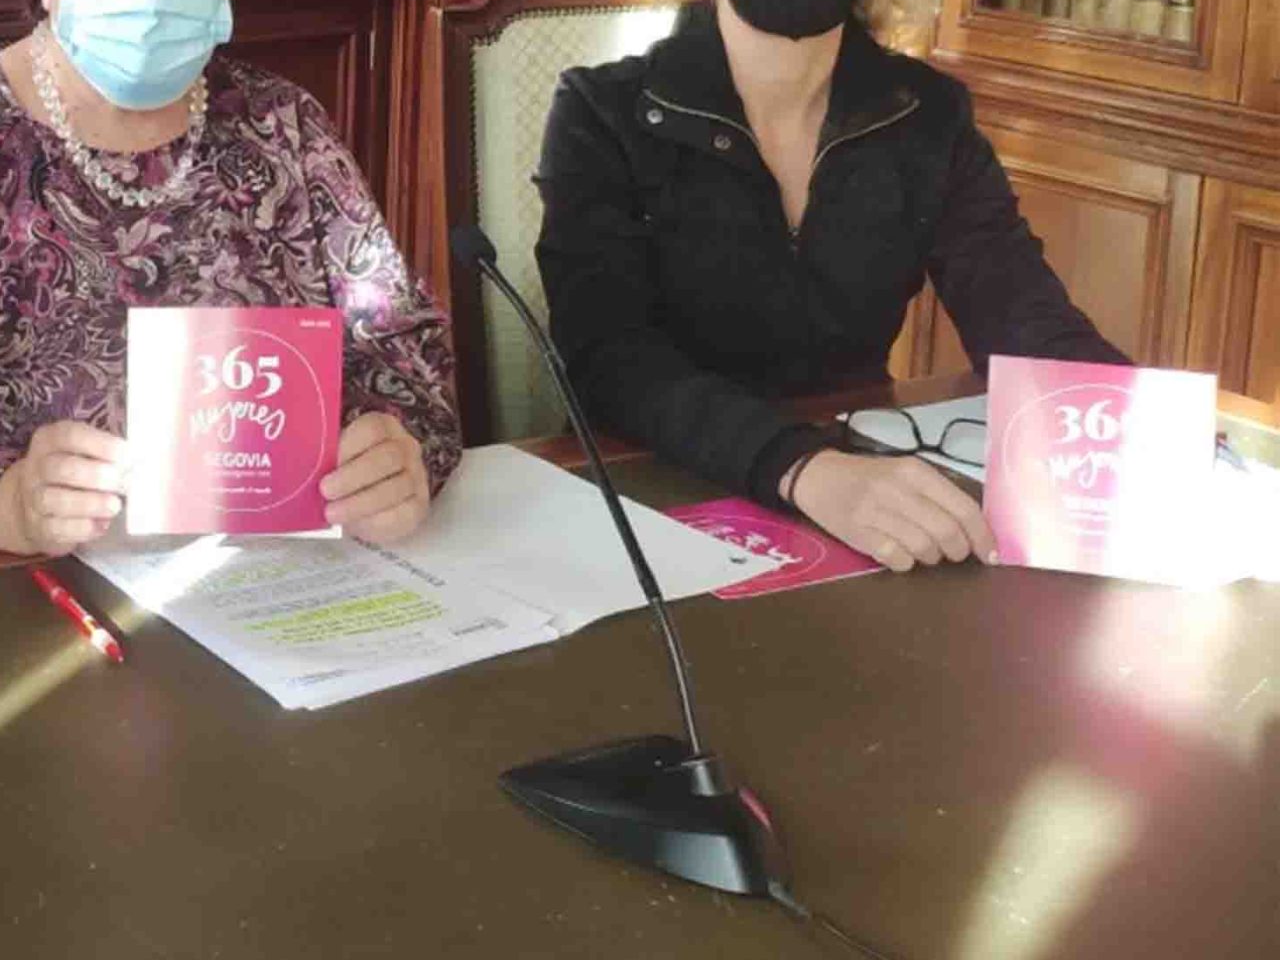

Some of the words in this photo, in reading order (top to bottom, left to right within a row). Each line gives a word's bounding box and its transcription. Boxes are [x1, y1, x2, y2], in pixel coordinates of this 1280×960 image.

[197, 344, 282, 399] 365
[190, 401, 286, 443] Mujeres
[1054, 399, 1122, 445] 36
